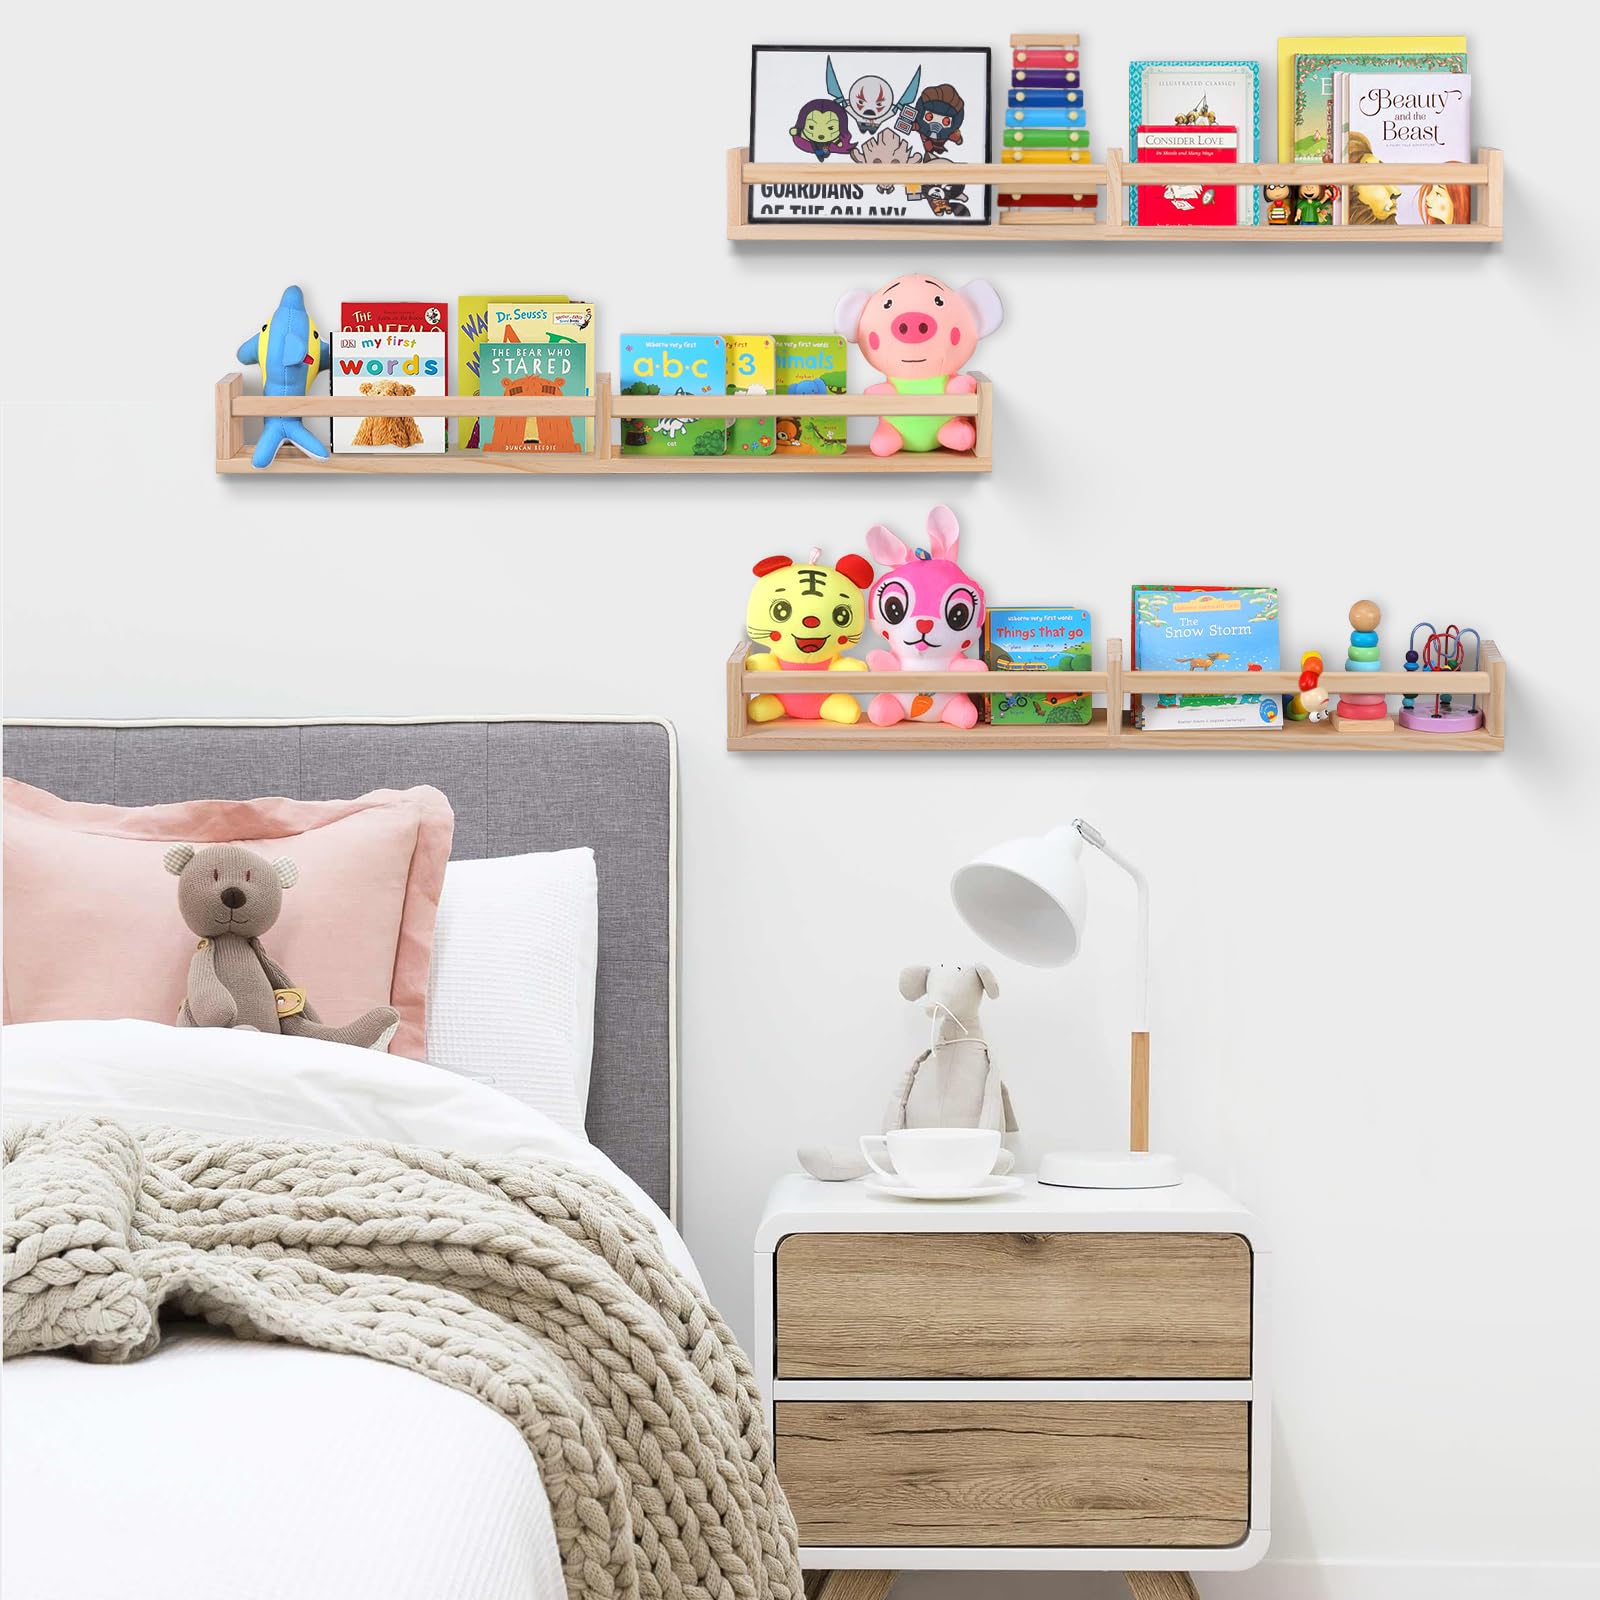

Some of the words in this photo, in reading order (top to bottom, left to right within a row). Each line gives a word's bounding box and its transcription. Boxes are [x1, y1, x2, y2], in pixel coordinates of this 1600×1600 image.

[1360, 88, 1462, 117] Beauty
[1394, 112, 1411, 121] and
[1413, 112, 1427, 121] the
[1382, 121, 1446, 146] Beast
[496, 311, 513, 324] Dr.
[514, 308, 548, 322] Seuss's
[362, 339, 382, 349] my
[386, 335, 417, 348] first
[491, 348, 510, 357] THE
[517, 348, 542, 357] BEAR
[547, 348, 571, 357] WHO
[340, 354, 438, 376] words
[491, 357, 571, 375] STARED
[1179, 617, 1199, 627] The
[996, 625, 1036, 641] Things
[1038, 625, 1066, 639] that
[1068, 628, 1084, 641] go
[1165, 626, 1204, 639] Snow
[1209, 624, 1252, 637] Storm
